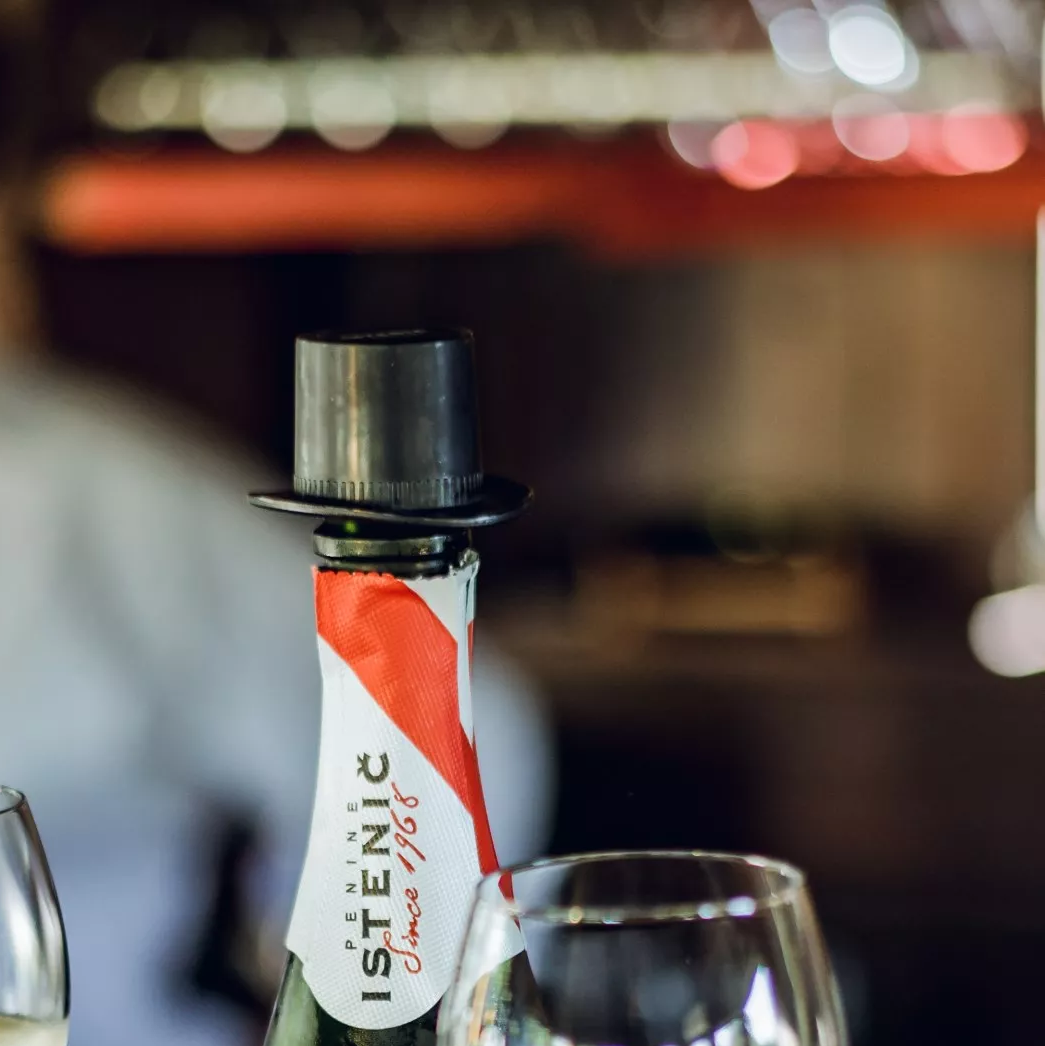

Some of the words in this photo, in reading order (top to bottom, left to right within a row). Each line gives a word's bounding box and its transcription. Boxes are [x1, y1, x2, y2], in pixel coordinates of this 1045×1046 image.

[345, 802, 358, 950] PENINE
[357, 752, 392, 1002] ISTENIČ
[390, 781, 427, 874] 1968
[383, 887, 422, 975] Since
